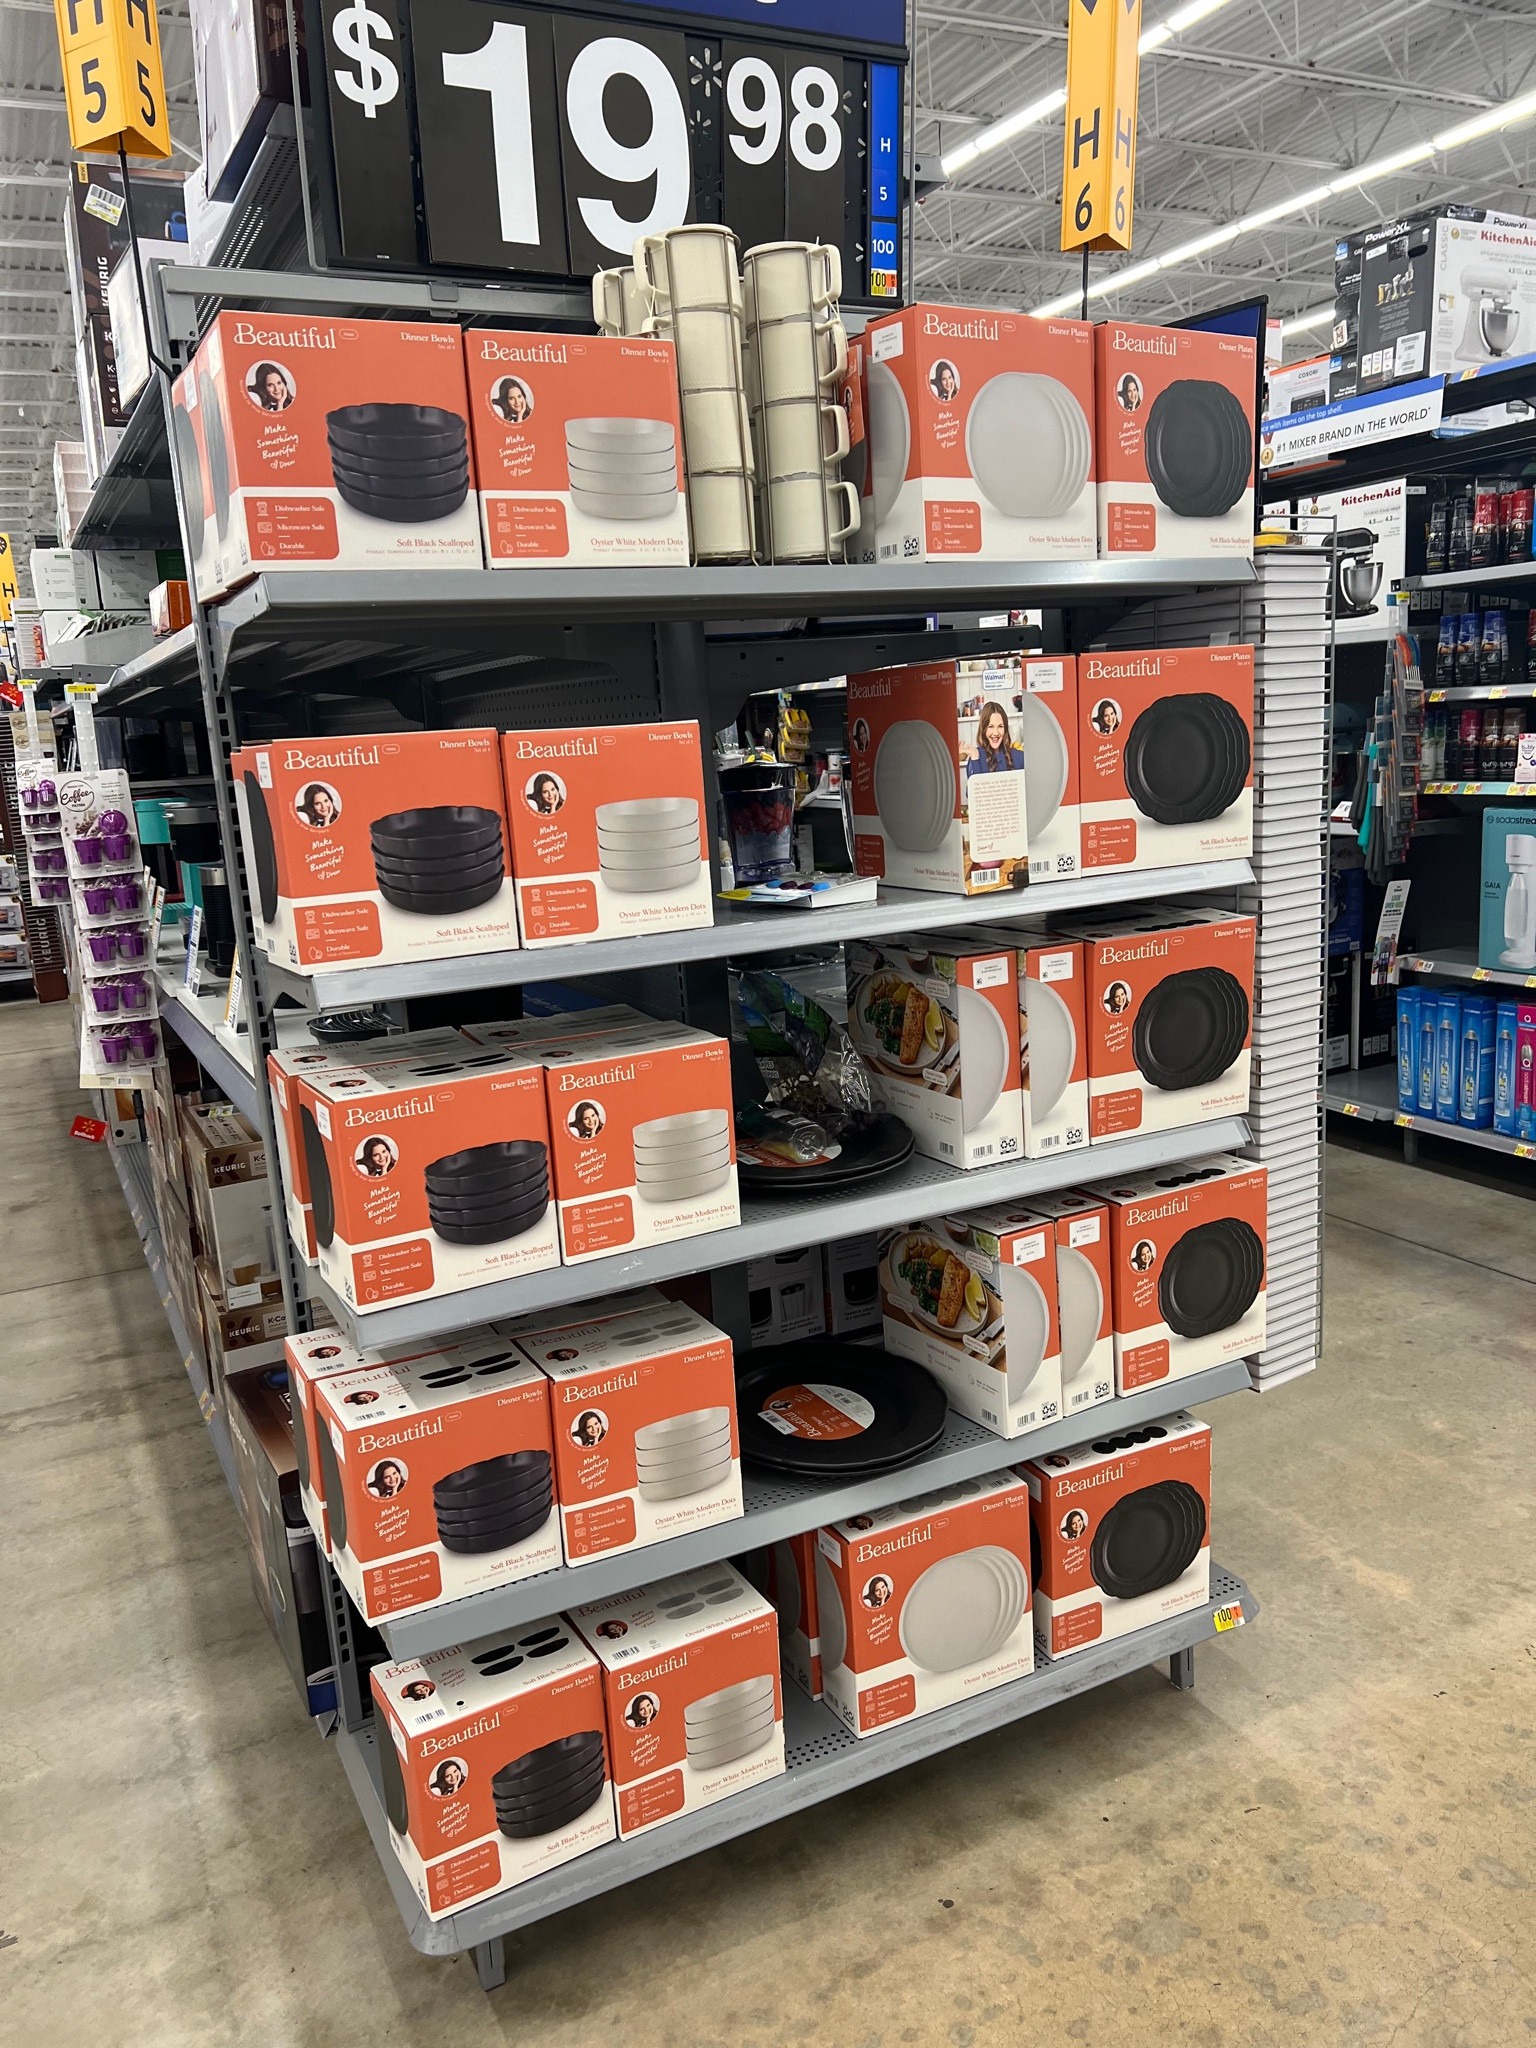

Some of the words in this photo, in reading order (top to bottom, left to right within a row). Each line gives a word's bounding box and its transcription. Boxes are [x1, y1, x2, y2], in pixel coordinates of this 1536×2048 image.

[81, 58, 106, 123] 5
[137, 59, 155, 127] 5
[332, 0, 399, 118] $
[441, 20, 690, 256] 19
[726, 56, 842, 172] 98
[1073, 107, 1100, 169] H
[880, 137, 891, 153] H
[1115, 108, 1131, 169] H
[879, 187, 888, 201] 5
[1075, 182, 1092, 232] 6
[1115, 185, 1124, 232] 6
[1365, 222, 1411, 244] PowerXL
[872, 239, 894, 254] 100
[1440, 226, 1449, 271] CLASSIC
[871, 272, 886, 287] 100
[233, 322, 337, 350] Beautiful
[923, 313, 1000, 341] Beautiful
[1048, 325, 1071, 336] Dinner
[1071, 327, 1089, 338] Plates
[400, 331, 429, 344] Dinner
[430, 333, 455, 345] Bowls
[1112, 330, 1178, 357] Beautiful
[1218, 341, 1238, 352] Dinner
[1237, 343, 1253, 354] Plates
[480, 340, 568, 364] Beautiful
[621, 347, 646, 357] Dinner
[647, 348, 669, 358] Bowls
[1298, 369, 1319, 379] COSORI
[264, 424, 287, 435] Make
[1269, 421, 1282, 430] with
[1282, 418, 1297, 427] items
[1306, 413, 1316, 421] the
[1316, 410, 1327, 421] top
[256, 433, 299, 449] Something
[1276, 443, 1286, 453] #1
[1289, 435, 1317, 450] MIXER
[1319, 427, 1352, 444] BRAND
[1354, 423, 1365, 435] IN
[1368, 418, 1387, 432] THE
[262, 444, 297, 460] Beautiful
[1341, 486, 1402, 506] KitchenAid
[396, 538, 413, 547] Soft
[414, 538, 437, 547] Black
[438, 538, 474, 549] Scalloped
[590, 538, 615, 548] Oyster
[615, 538, 637, 546] White
[637, 538, 665, 547] Modern
[666, 538, 684, 546] Dots
[2, 583, 15, 598] H
[1210, 654, 1231, 662] Dinner
[1232, 652, 1250, 661] Plates
[985, 673, 1006, 681] Walmart
[1086, 657, 1161, 679] Beautiful
[850, 678, 891, 700] Beautiful
[440, 741, 465, 749] Dinner
[467, 739, 490, 748] Bowls
[648, 733, 672, 742] Dinner
[673, 732, 693, 740] Bowls
[284, 745, 380, 770] Beautiful
[516, 737, 598, 760] Beautiful
[5, 762, 19, 809] KEURIG
[61, 788, 94, 805] Coffee
[305, 845, 344, 863] Something
[312, 838, 333, 850] Make
[310, 856, 342, 872] Beautiful
[619, 910, 641, 920] Oyster
[642, 908, 663, 917] White
[663, 905, 690, 915] Modern
[690, 903, 706, 912] Dots
[436, 929, 451, 938] Soft
[451, 926, 475, 936] Black
[476, 922, 510, 936] Scalloped
[1214, 930, 1234, 940] Dinner
[1235, 927, 1252, 936] Plates
[42, 917, 52, 964] KEURIG
[1099, 938, 1169, 965] Beautiful
[682, 1052, 704, 1062] Dinner
[705, 1049, 724, 1058] Bowls
[490, 1081, 516, 1091] Dinner
[517, 1077, 538, 1087] Bowls
[559, 1063, 636, 1092] Beautiful
[344, 1094, 435, 1128] Beautiful
[214, 1161, 246, 1174] KEURIG
[369, 1185, 390, 1199] Make
[1229, 1181, 1248, 1190] Dinner
[1249, 1177, 1264, 1186] Plates
[363, 1190, 401, 1210] Something
[367, 1201, 399, 1219] Beautiful
[653, 1217, 675, 1228] Oyster
[675, 1212, 693, 1223] White
[694, 1207, 719, 1218] Modern
[720, 1203, 735, 1213] Dots
[1126, 1196, 1189, 1227] Beautiful
[484, 1255, 499, 1265] Soft
[500, 1251, 520, 1262] Black
[521, 1243, 554, 1259] Scalloped
[229, 1324, 260, 1338] KEURIG
[683, 1354, 705, 1364] Dinner
[706, 1348, 725, 1359] Bowls
[329, 1365, 411, 1391] Beautiful
[563, 1370, 638, 1403] Beautiful
[497, 1395, 522, 1407] Dinner
[523, 1389, 543, 1401] Bowls
[357, 1416, 444, 1454] Beautiful
[1169, 1442, 1189, 1454] Dinner
[1189, 1437, 1207, 1449] Plates
[1055, 1463, 1124, 1499] Beautiful
[380, 1504, 400, 1518] Make
[655, 1514, 675, 1526] Oyster
[676, 1510, 695, 1521] White
[696, 1503, 720, 1515] Modern
[720, 1497, 736, 1507] Dots
[982, 1499, 1004, 1513] Dinner
[1005, 1494, 1024, 1506] Plates
[374, 1508, 410, 1531] Something
[378, 1518, 408, 1538] Beautiful
[856, 1524, 932, 1563] Beautiful
[490, 1562, 504, 1571] Soft
[505, 1556, 525, 1568] Black
[525, 1545, 557, 1565] Scalloped
[578, 1589, 646, 1618] Beautiful
[1217, 1607, 1232, 1623] 100
[731, 1628, 752, 1641] Dinner
[752, 1621, 771, 1633] Bowls
[385, 1645, 462, 1680] Beautiful
[617, 1651, 688, 1691] Beautiful
[551, 1681, 574, 1695] Dinner
[575, 1674, 595, 1688] Bowls
[420, 1713, 501, 1757] Beautiful
[702, 1779, 722, 1793] Oyster
[722, 1771, 740, 1784] White
[740, 1762, 764, 1777] Modern
[764, 1756, 779, 1767] Dots
[436, 1803, 471, 1828] Something
[442, 1801, 461, 1816] Make
[440, 1813, 468, 1834] Beautiful
[546, 1841, 561, 1852] Soft
[561, 1833, 579, 1846] Black
[580, 1818, 610, 1839] Scalloped
